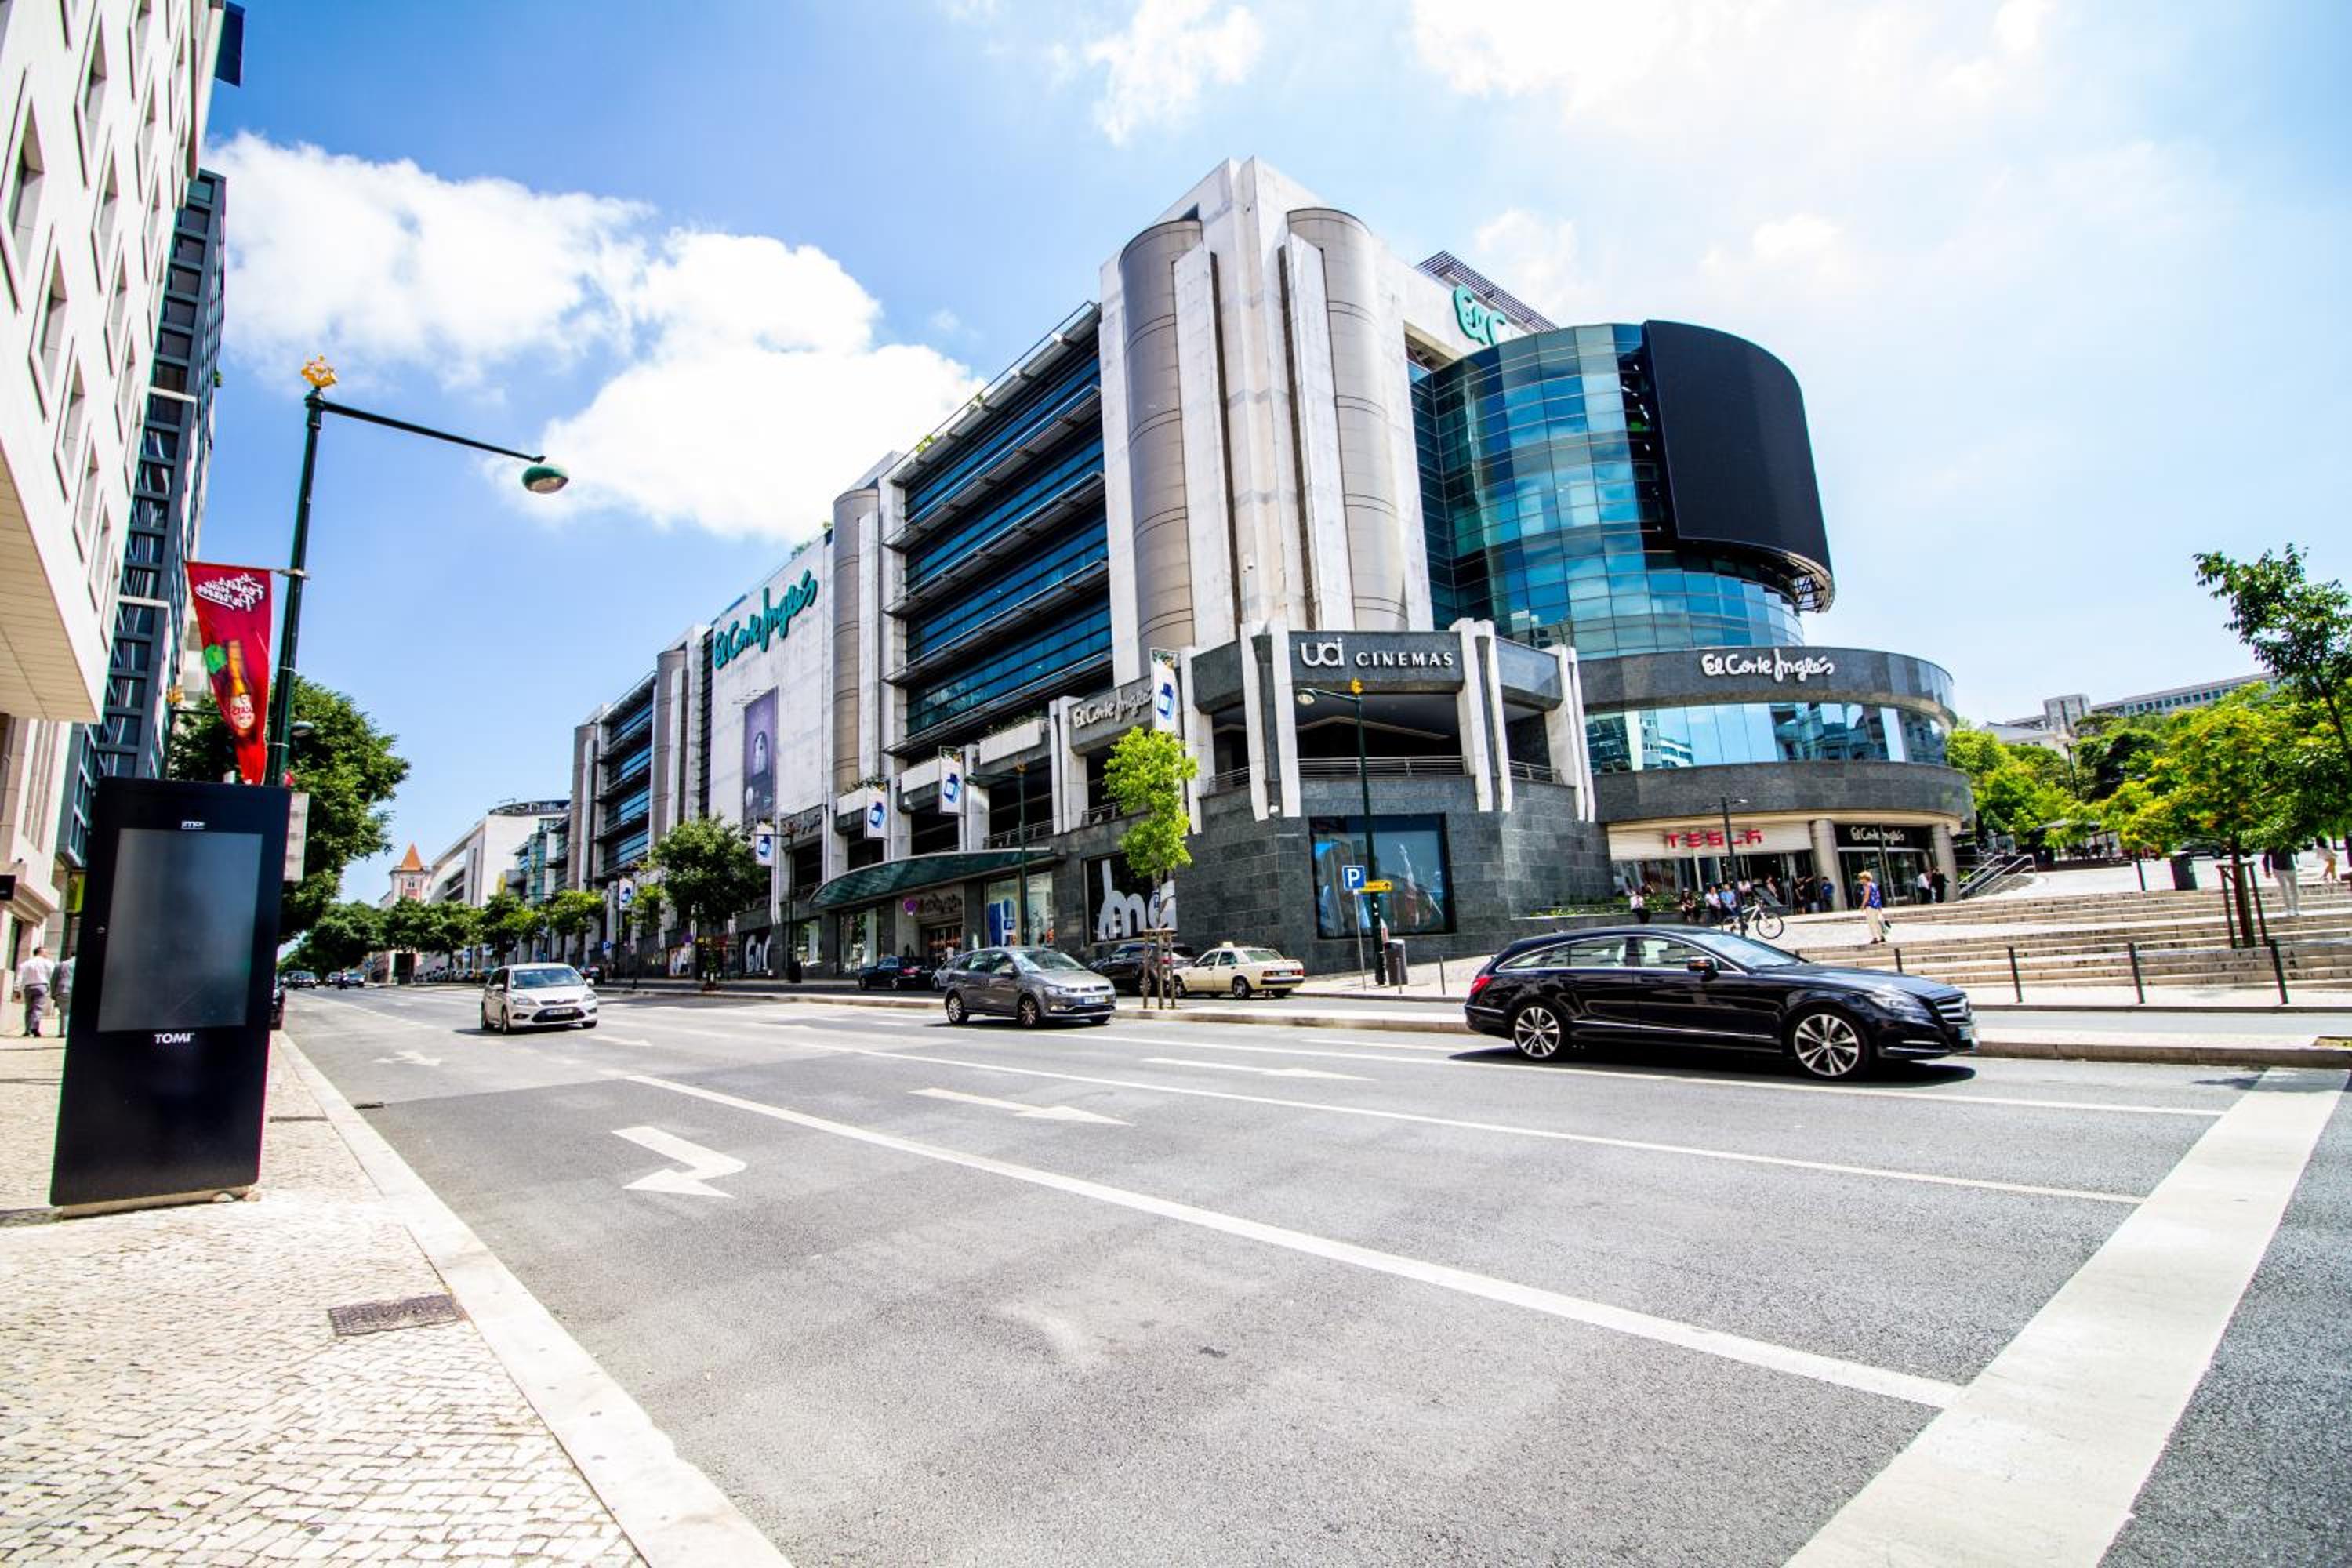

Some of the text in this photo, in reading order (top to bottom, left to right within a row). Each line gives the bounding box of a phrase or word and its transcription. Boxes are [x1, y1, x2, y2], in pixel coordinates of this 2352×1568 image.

[1355, 652, 1454, 666] CINEMAS
[1701, 648, 1835, 682] El Corte Inglés
[1073, 708, 1085, 728] El
[1085, 702, 1114, 723] Corte
[1348, 868, 1360, 887] P
[154, 1033, 191, 1044] TOMI
